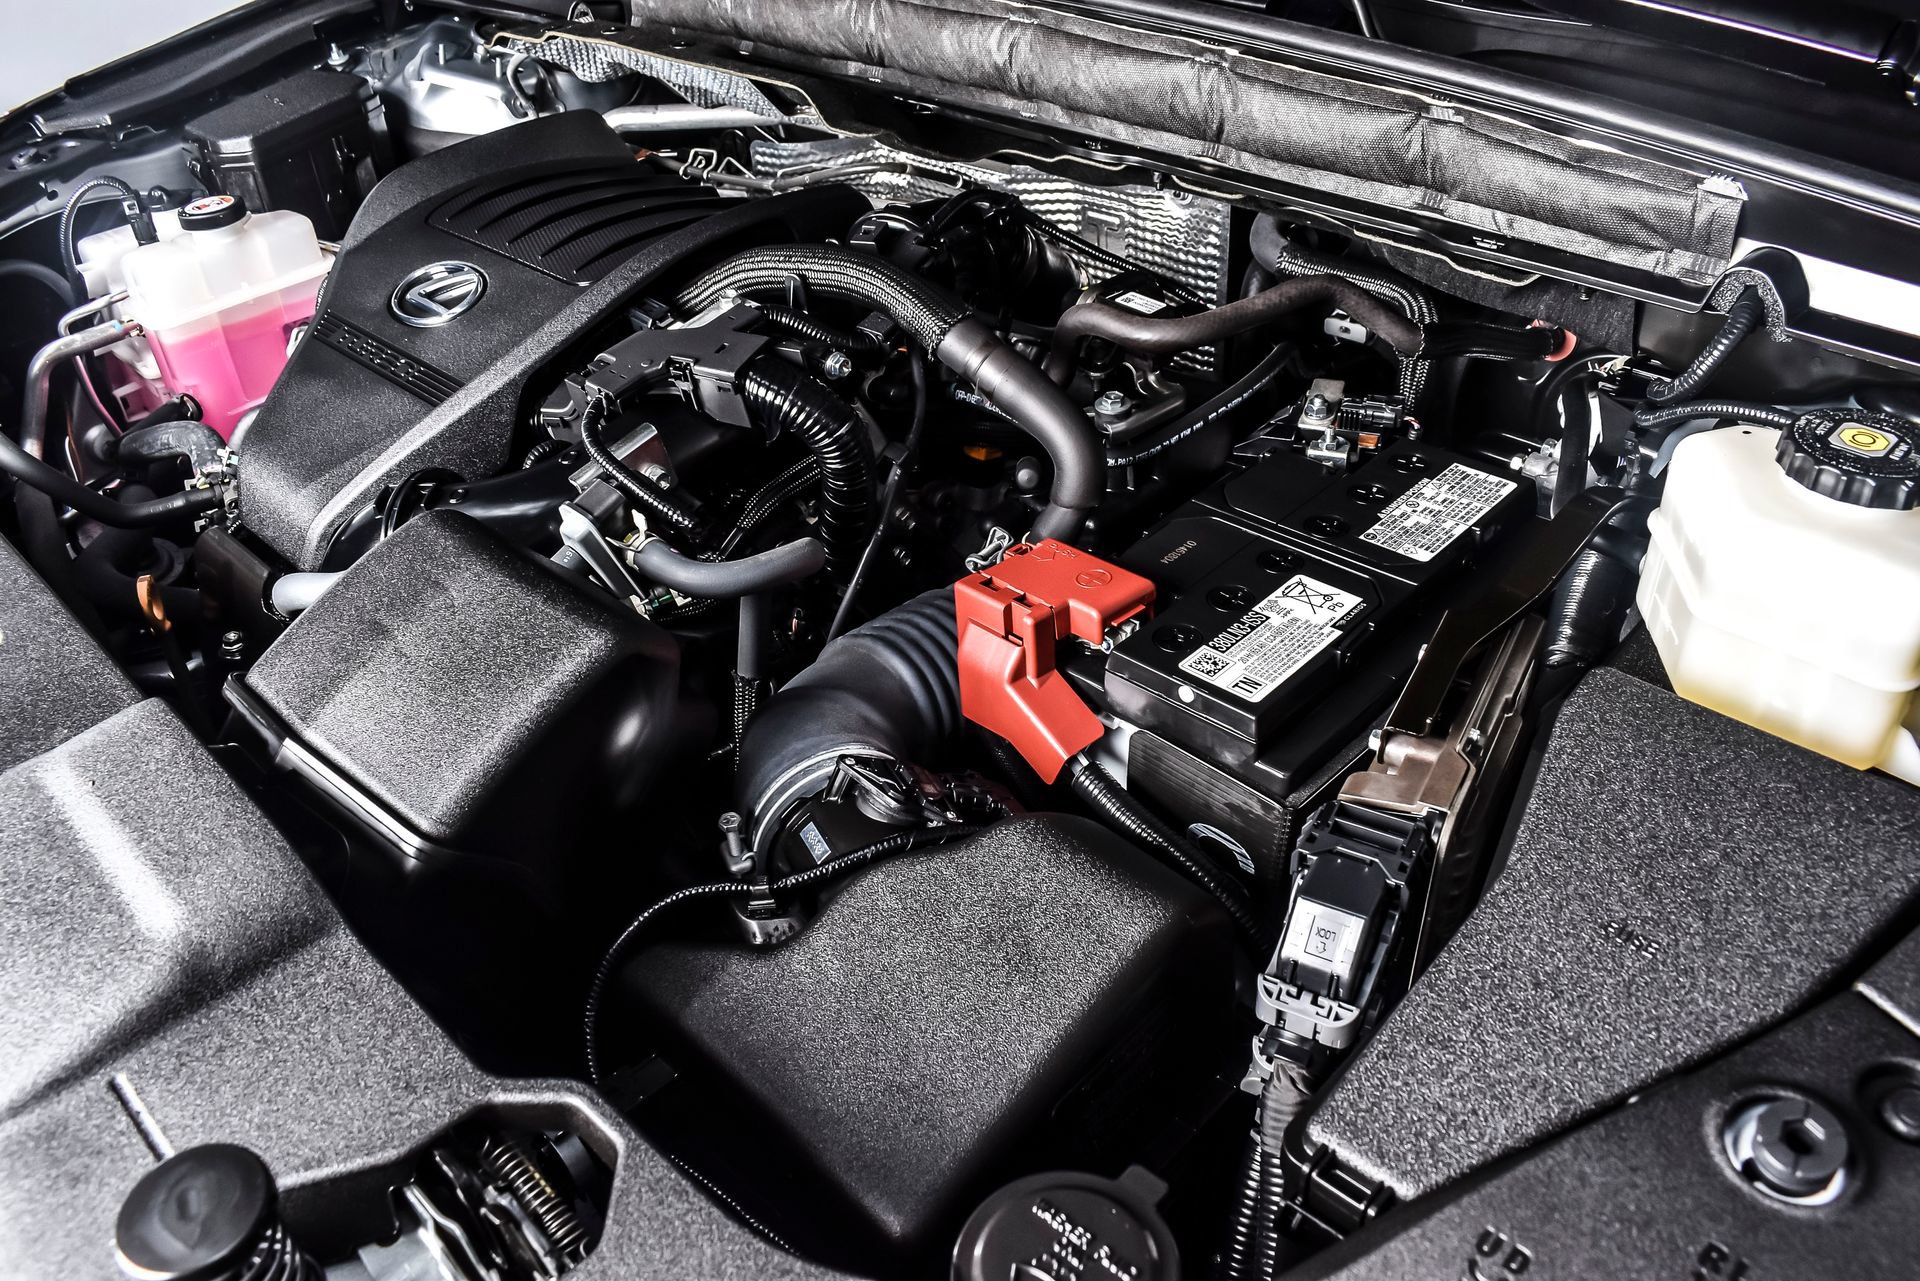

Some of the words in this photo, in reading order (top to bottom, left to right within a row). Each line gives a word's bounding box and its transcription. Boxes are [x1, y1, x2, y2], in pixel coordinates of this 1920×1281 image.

[1326, 600, 1345, 612] Pb
[1342, 602, 1368, 621] CLARIOS
[1208, 612, 1268, 652] 380LN3-ISS
[1231, 676, 1262, 696] TN
[1315, 926, 1337, 942] LOCK
